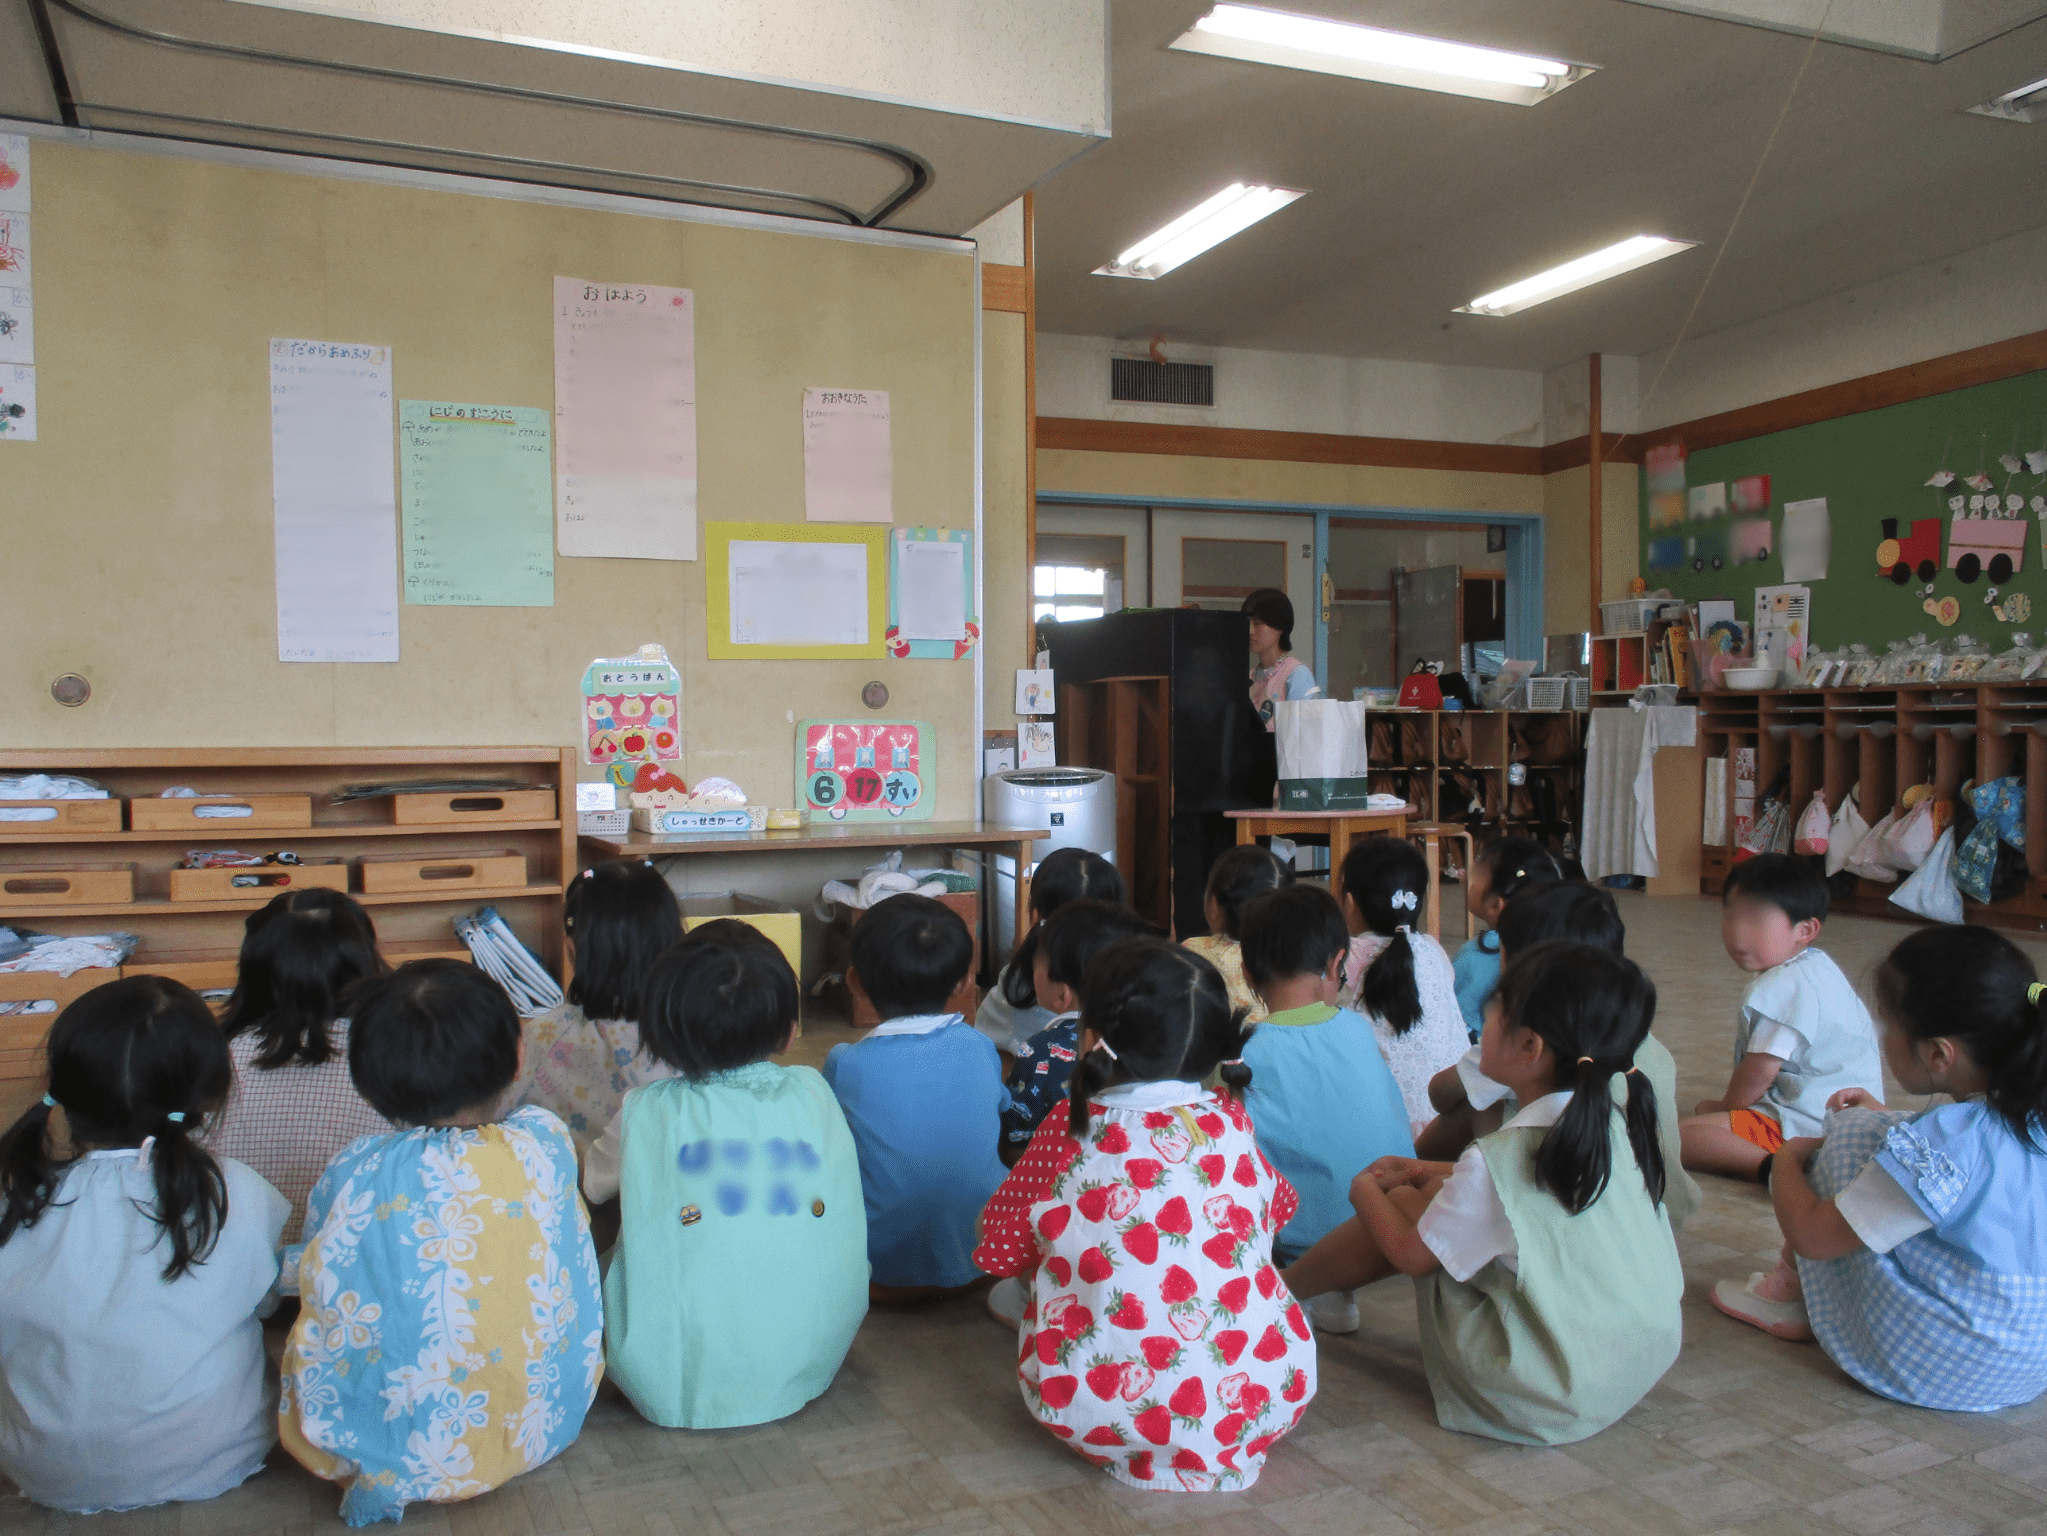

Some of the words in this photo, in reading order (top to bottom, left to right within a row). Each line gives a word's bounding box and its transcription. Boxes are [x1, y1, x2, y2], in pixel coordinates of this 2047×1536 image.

[583, 286, 646, 305] おはよう
[290, 342, 371, 361] だからあめふり
[821, 392, 867, 404] おおきなうた
[429, 405, 513, 420] にじのむこうに
[602, 672, 665, 683] おとうばん
[814, 776, 835, 803] 6
[855, 776, 879, 802] 17
[886, 779, 917, 802] すい
[671, 815, 744, 826] しゅっせきかーど
